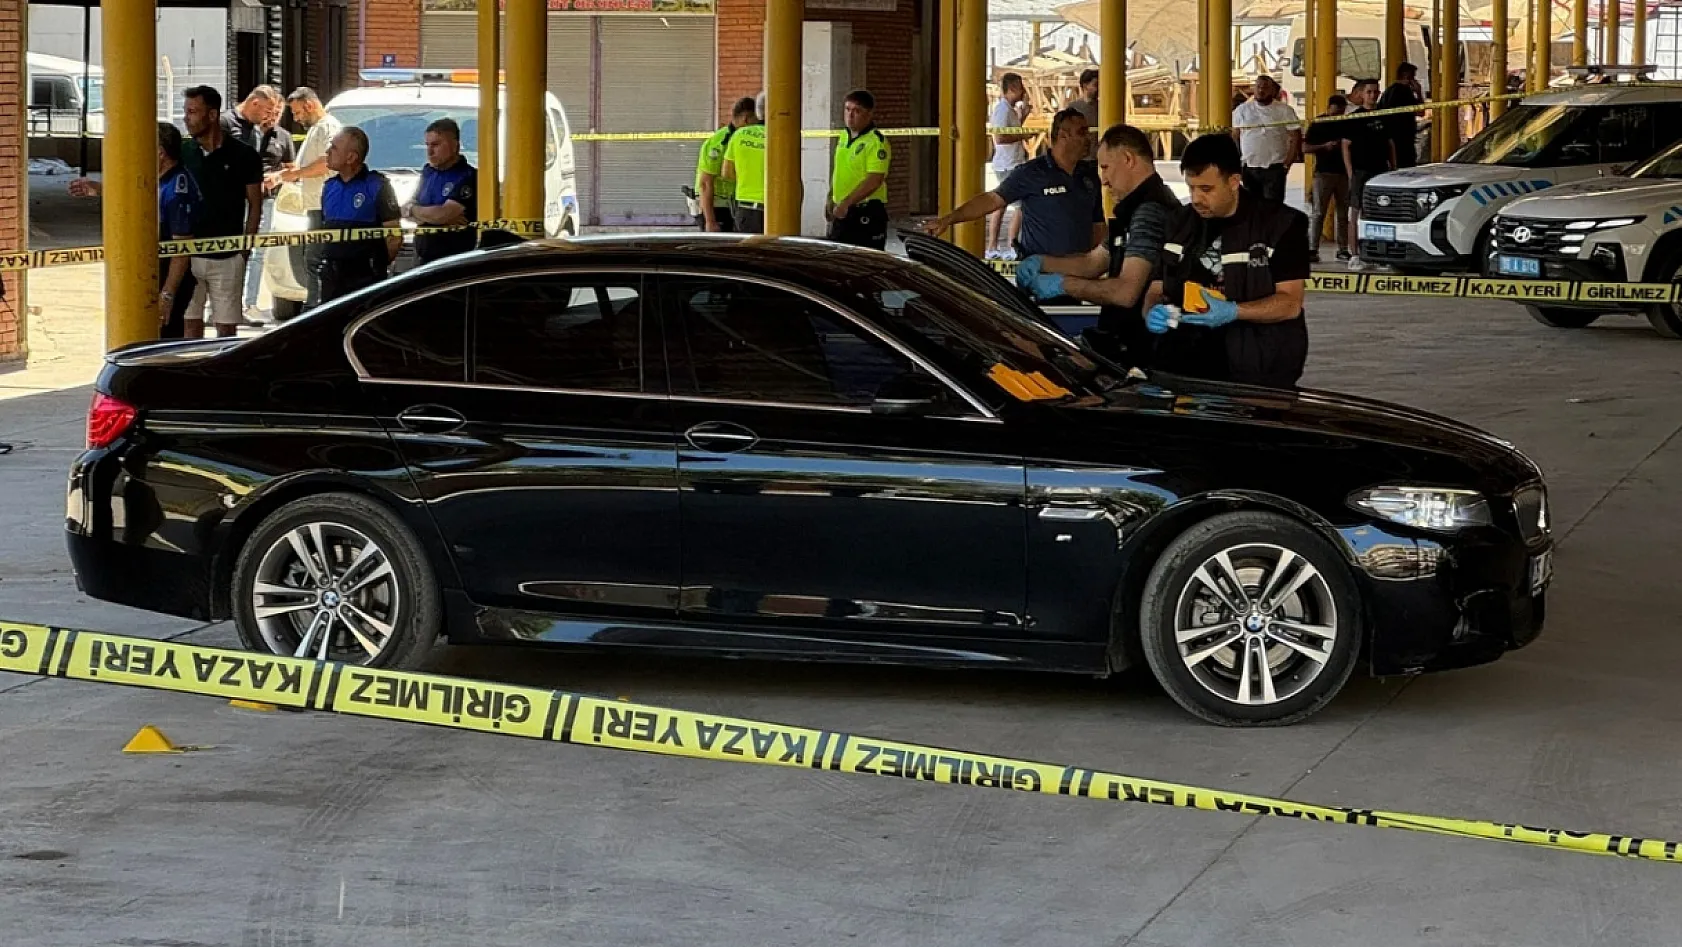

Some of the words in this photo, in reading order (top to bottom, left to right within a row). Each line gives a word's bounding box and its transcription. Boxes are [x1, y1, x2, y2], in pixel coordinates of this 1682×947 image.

[194, 238, 240, 252] KAZA
[1312, 276, 1350, 290] YERİ
[1375, 277, 1451, 293] GİRİLMEZ
[1471, 282, 1518, 296] KAZA
[1522, 283, 1562, 297] YERİ
[1587, 284, 1666, 299] GİRİLMEZ
[88, 639, 182, 680] YERİ
[191, 651, 303, 694] KAZA
[349, 672, 532, 729] GİRİLMEZ
[591, 705, 684, 748] YERİ
[694, 719, 809, 765] KAZA
